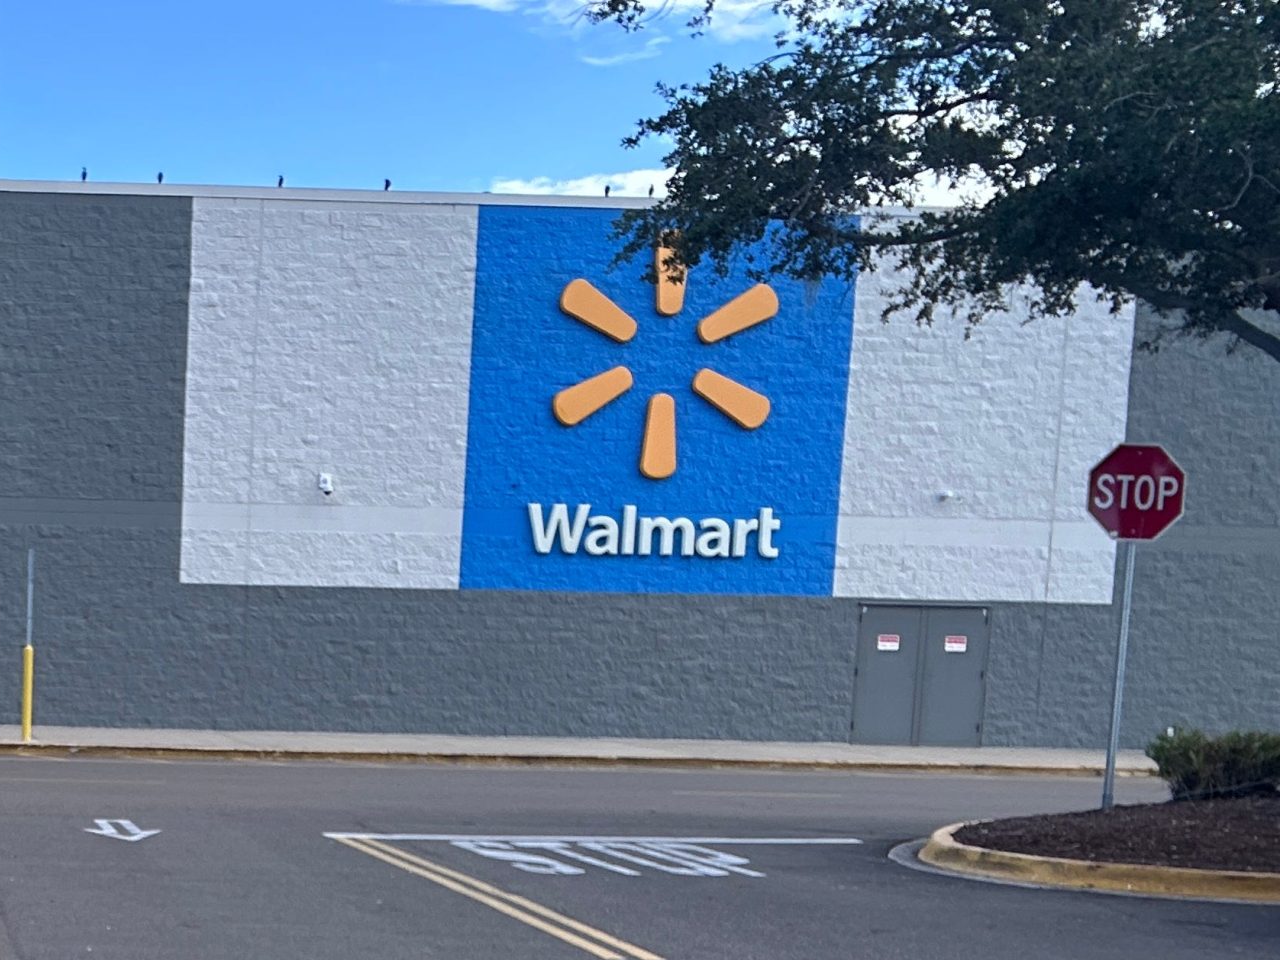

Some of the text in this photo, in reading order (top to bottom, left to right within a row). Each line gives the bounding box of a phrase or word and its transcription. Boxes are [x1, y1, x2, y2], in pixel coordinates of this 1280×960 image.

[1094, 473, 1179, 511] STOP
[527, 502, 781, 558] Walmart
[450, 840, 767, 876] STOP
